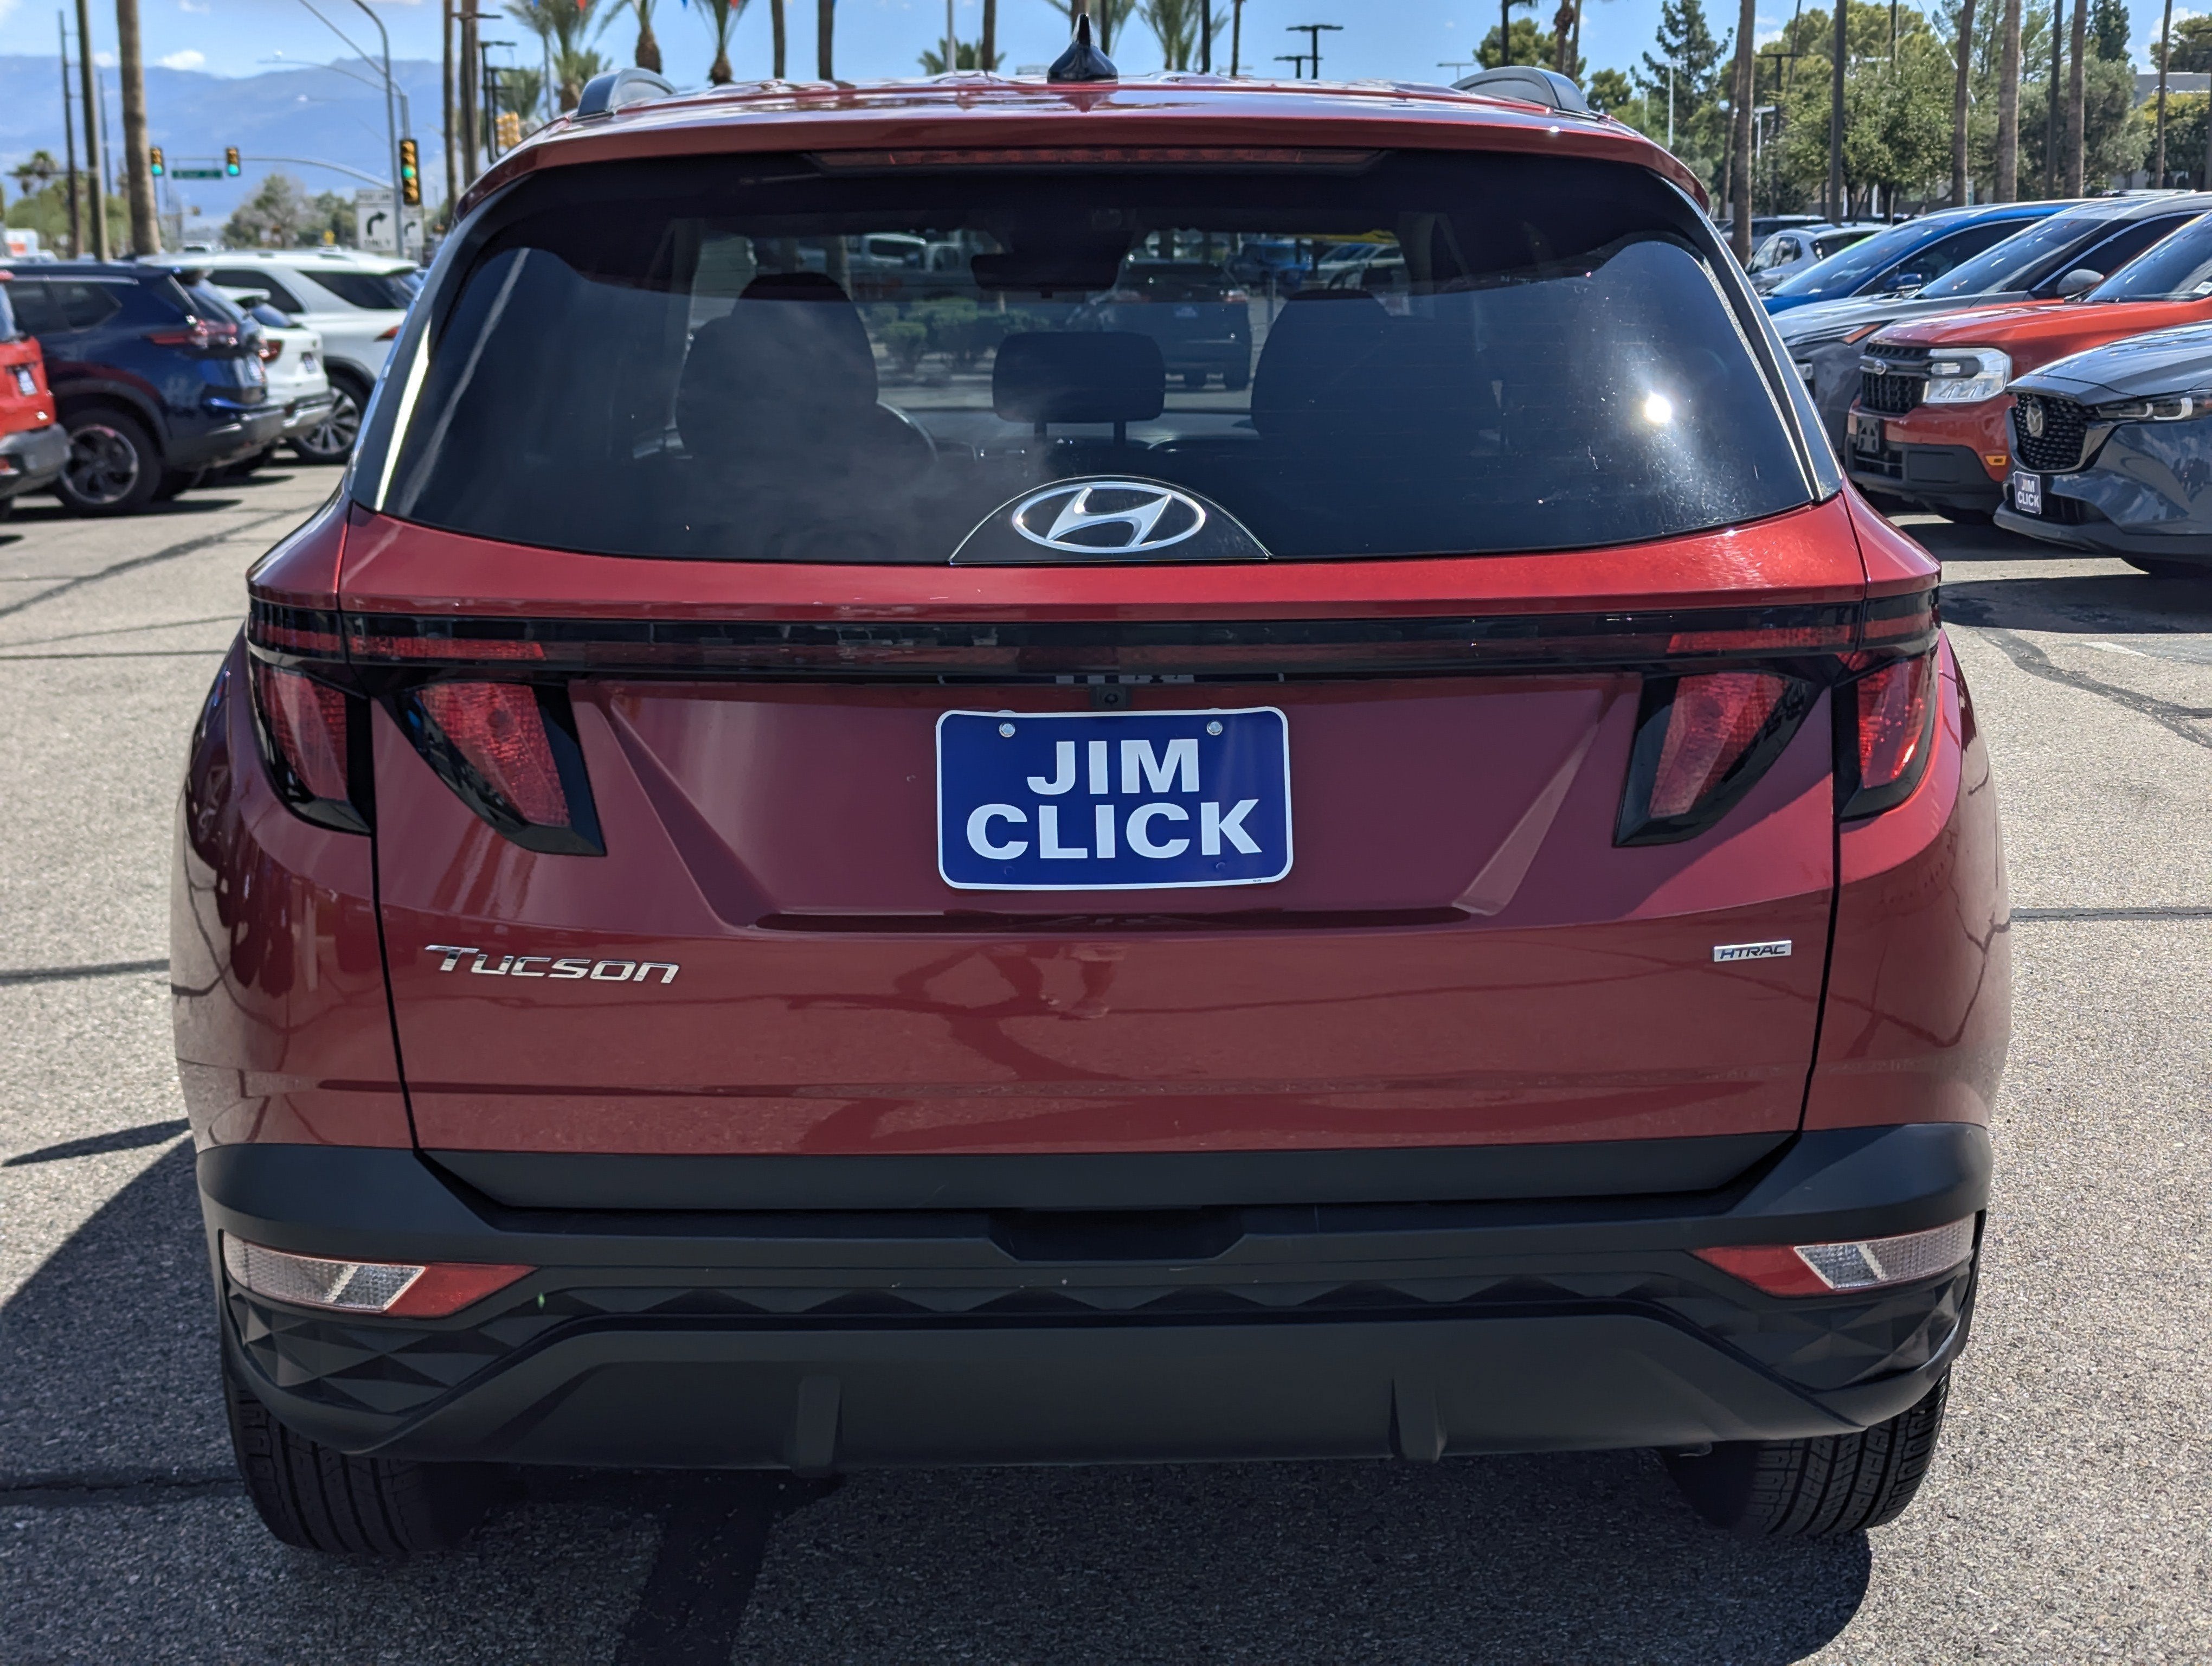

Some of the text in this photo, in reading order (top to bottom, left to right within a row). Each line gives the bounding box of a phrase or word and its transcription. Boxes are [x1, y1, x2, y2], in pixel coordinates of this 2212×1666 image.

[2021, 479, 2035, 493] JIM
[2017, 491, 2040, 508] CLICK
[1027, 739, 1199, 795] JIM
[967, 799, 1262, 860] CLICK
[1720, 945, 1786, 959] HTRAC
